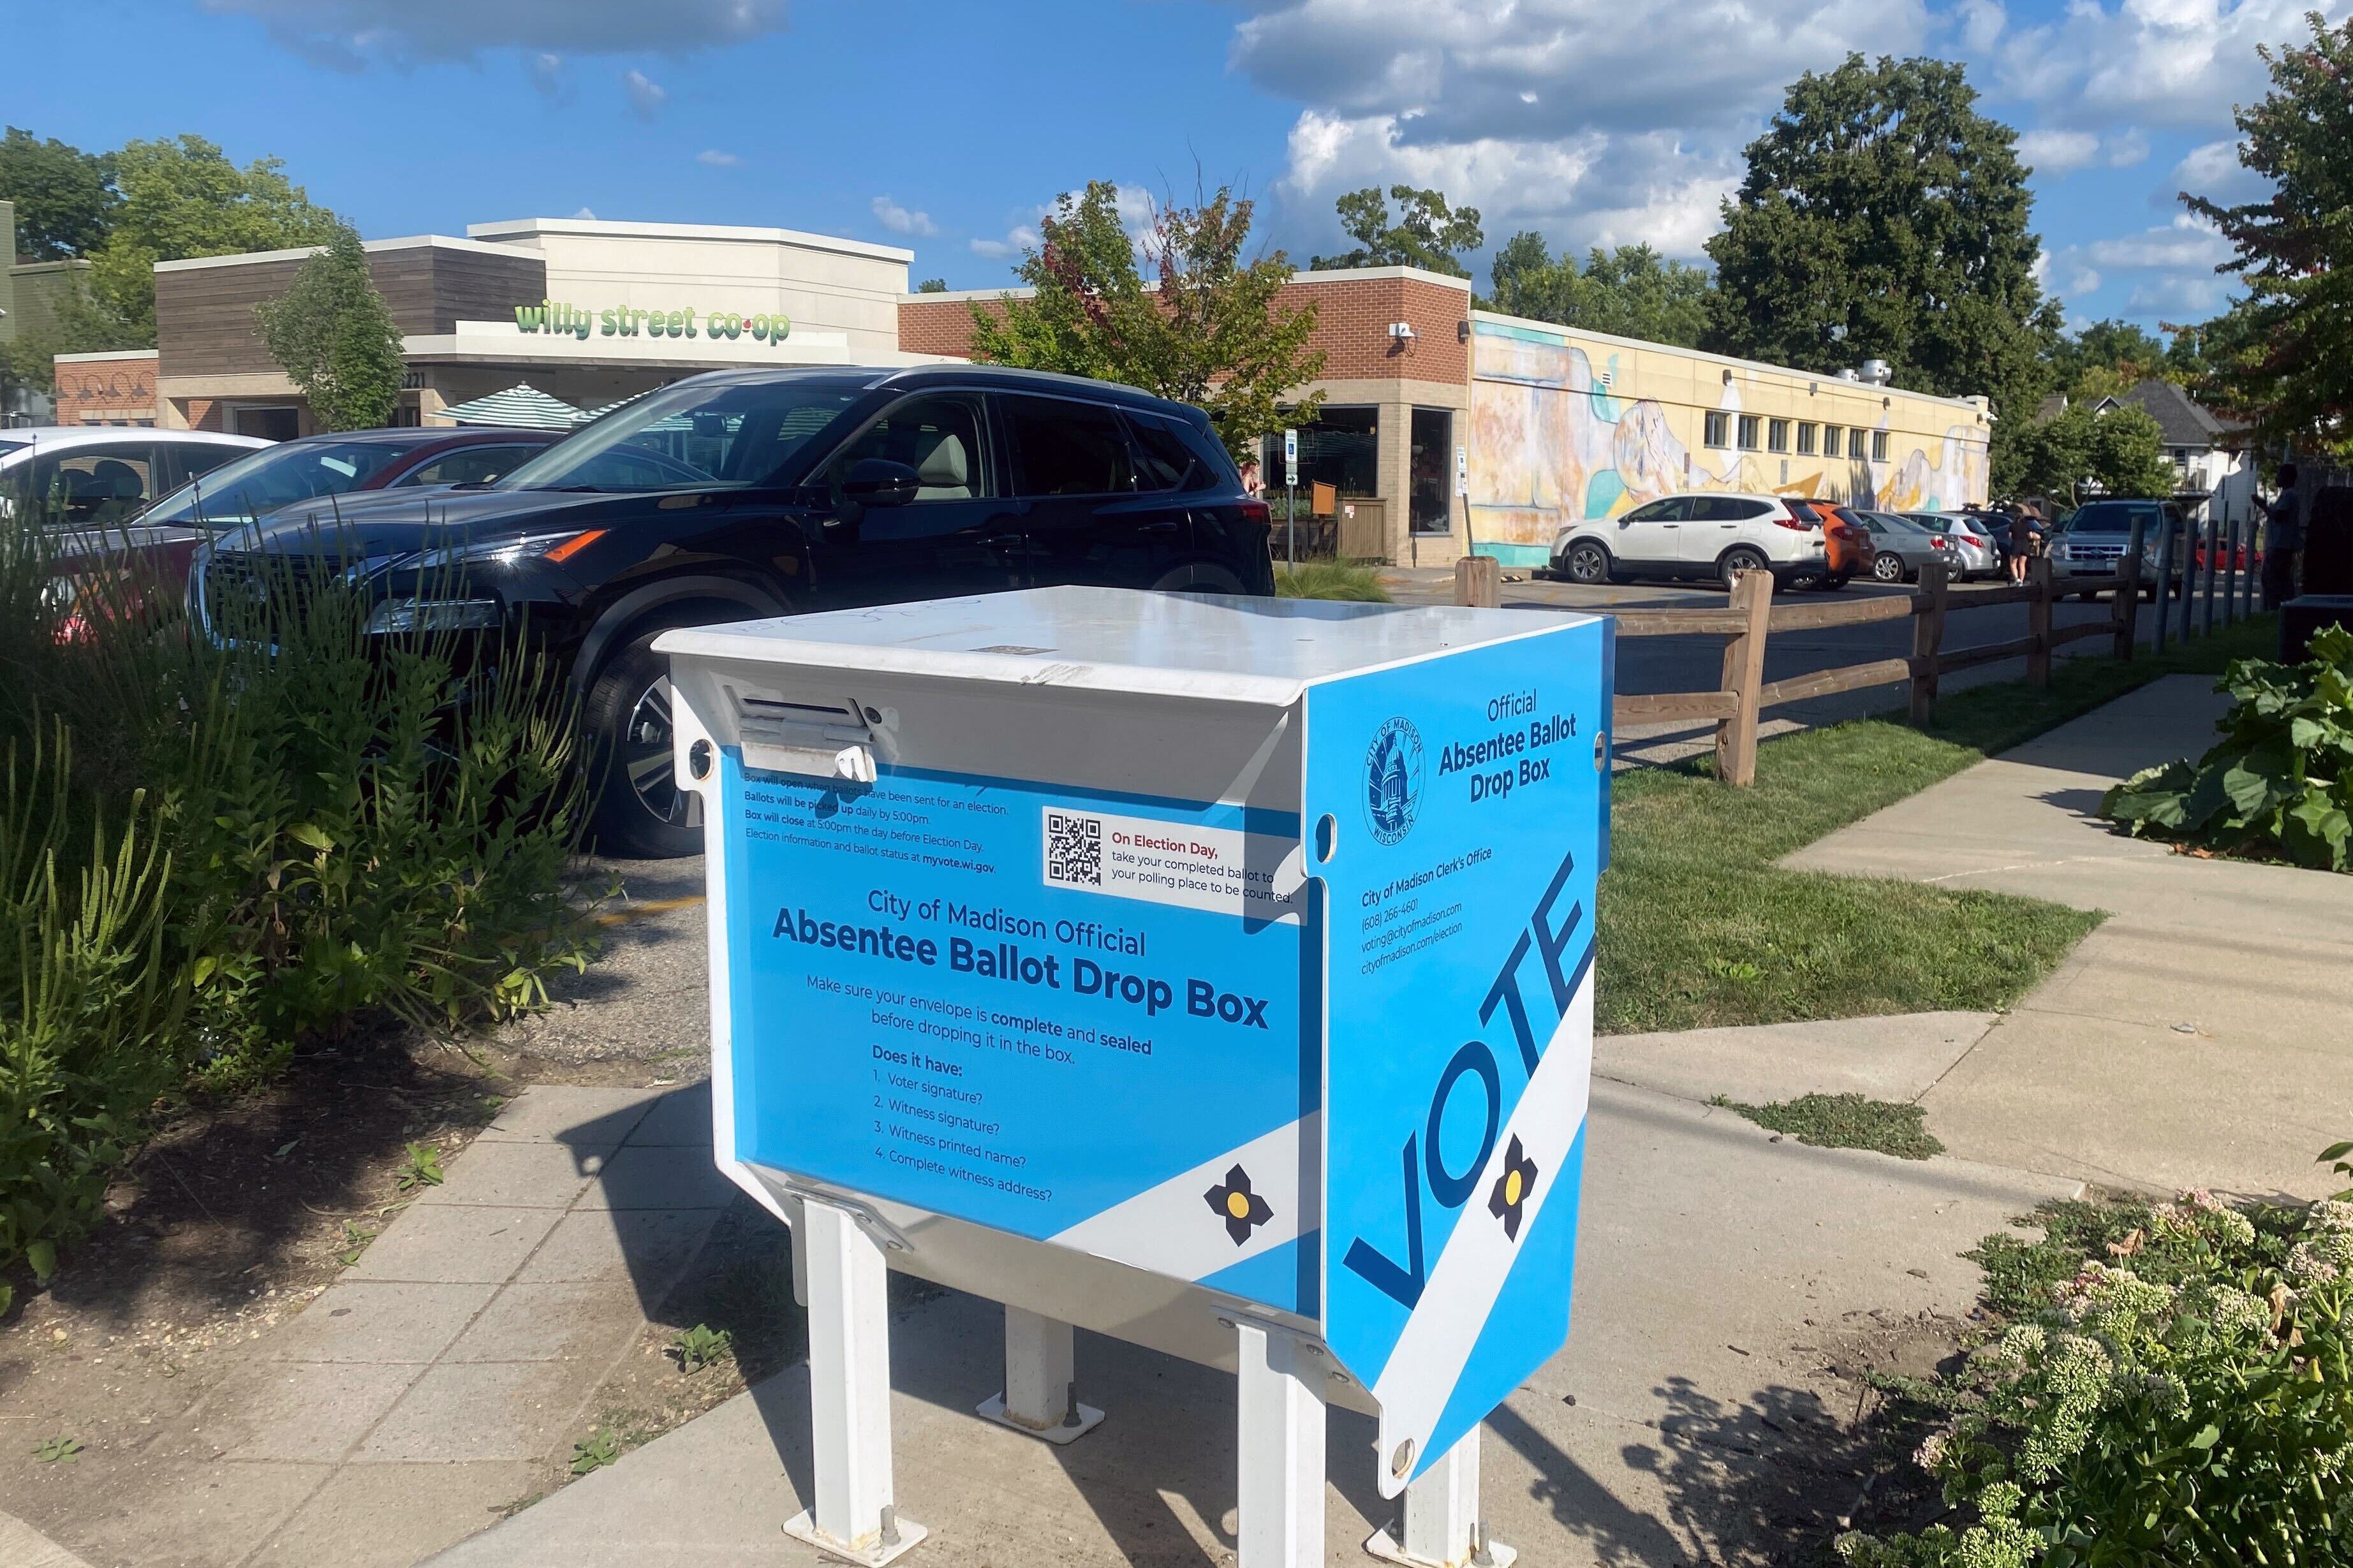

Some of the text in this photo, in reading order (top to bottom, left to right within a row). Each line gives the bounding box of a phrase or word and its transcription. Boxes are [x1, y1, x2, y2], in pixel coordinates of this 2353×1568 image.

[515, 299, 591, 340] willy
[600, 305, 697, 339] street
[1488, 689, 1536, 722] Official
[1366, 719, 1422, 766] CITY OF MADISON
[1439, 714, 1576, 776] Absentee Ballot
[744, 772, 1009, 816] Box will open when ballots have been sent for an election.
[1471, 758, 1550, 803] Drop Box
[745, 791, 774, 803] Ballots
[777, 796, 792, 806] will
[794, 798, 806, 808] be
[808, 800, 839, 812] picked
[841, 806, 853, 816] up
[856, 806, 878, 820] daily
[880, 809, 890, 821] by
[745, 809, 984, 853] Box will close at 5:00pm the day before Election Day.
[746, 828, 995, 874] Election information and ballot status at myvote.wi.gov.
[1112, 832, 1218, 860] On Election Day,
[1373, 814, 1414, 844] WISCONSIN
[1112, 851, 1273, 883] take your completed ballot to
[1112, 868, 1292, 904] your polling place to be counted.
[1362, 849, 1491, 907] City of Madison Clerk's Office
[869, 890, 1144, 956] City of Madison Official
[1361, 898, 1419, 934] (608) 266-4601
[1361, 902, 1462, 953] voting@cityofmadison.com
[773, 908, 1269, 1029] Absentee Ballot Drop Box
[1361, 921, 1463, 975] cityofmadison.com/election
[808, 974, 1151, 1055] Make sure your envelope is complete and sealed
[872, 1009, 1075, 1064] before dropping it in the box.
[873, 1045, 962, 1077] Does it have:
[1343, 851, 1595, 1311] VOTE
[873, 1069, 982, 1105] 1. Voter signature?
[874, 1095, 999, 1135] 2. Witness signature?
[874, 1120, 1026, 1168] 3. Witness printed name?
[875, 1147, 1052, 1201] 4. Complete witness address?
